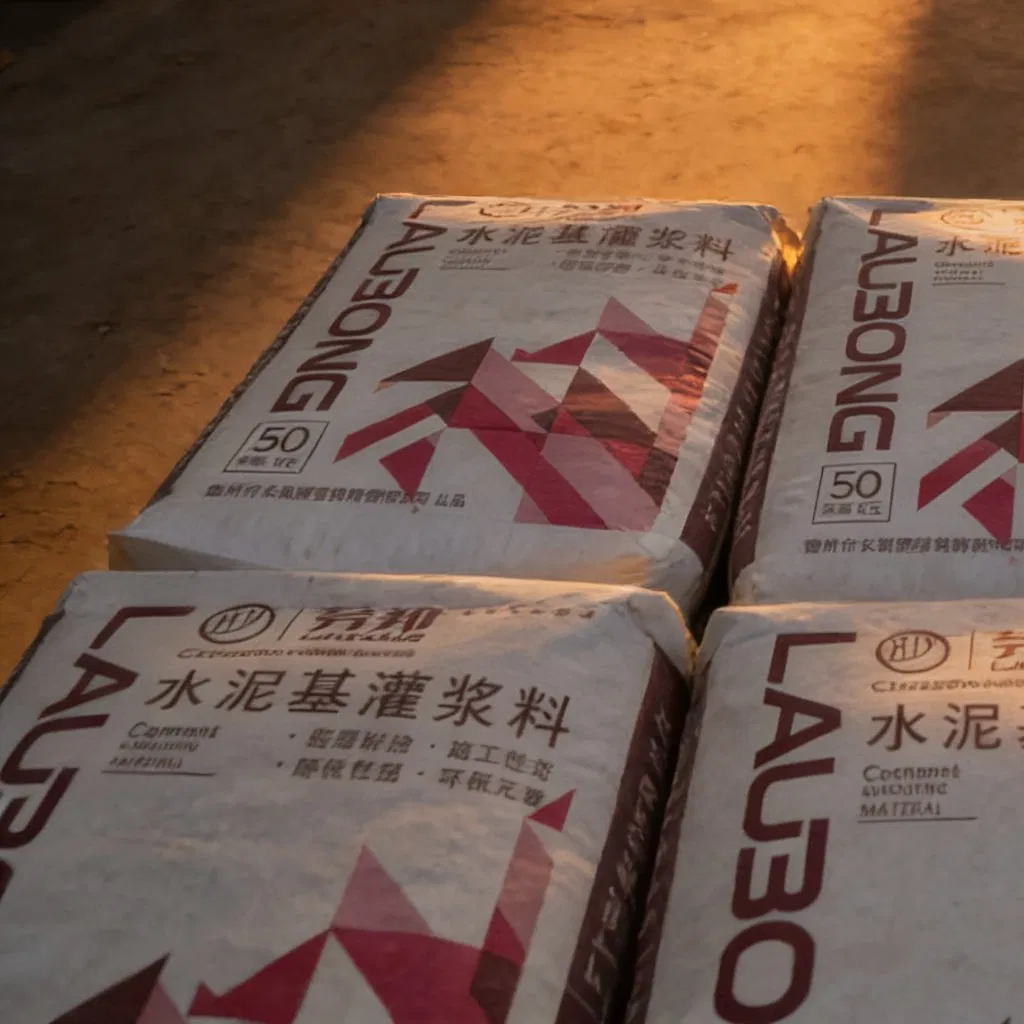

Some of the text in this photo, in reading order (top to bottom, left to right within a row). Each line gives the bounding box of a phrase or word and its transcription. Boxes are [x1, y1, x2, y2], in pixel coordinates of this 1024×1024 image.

[252, 426, 310, 452] 50
[830, 470, 882, 499] 50
[144, 669, 571, 749] 水泥基灌浆料
